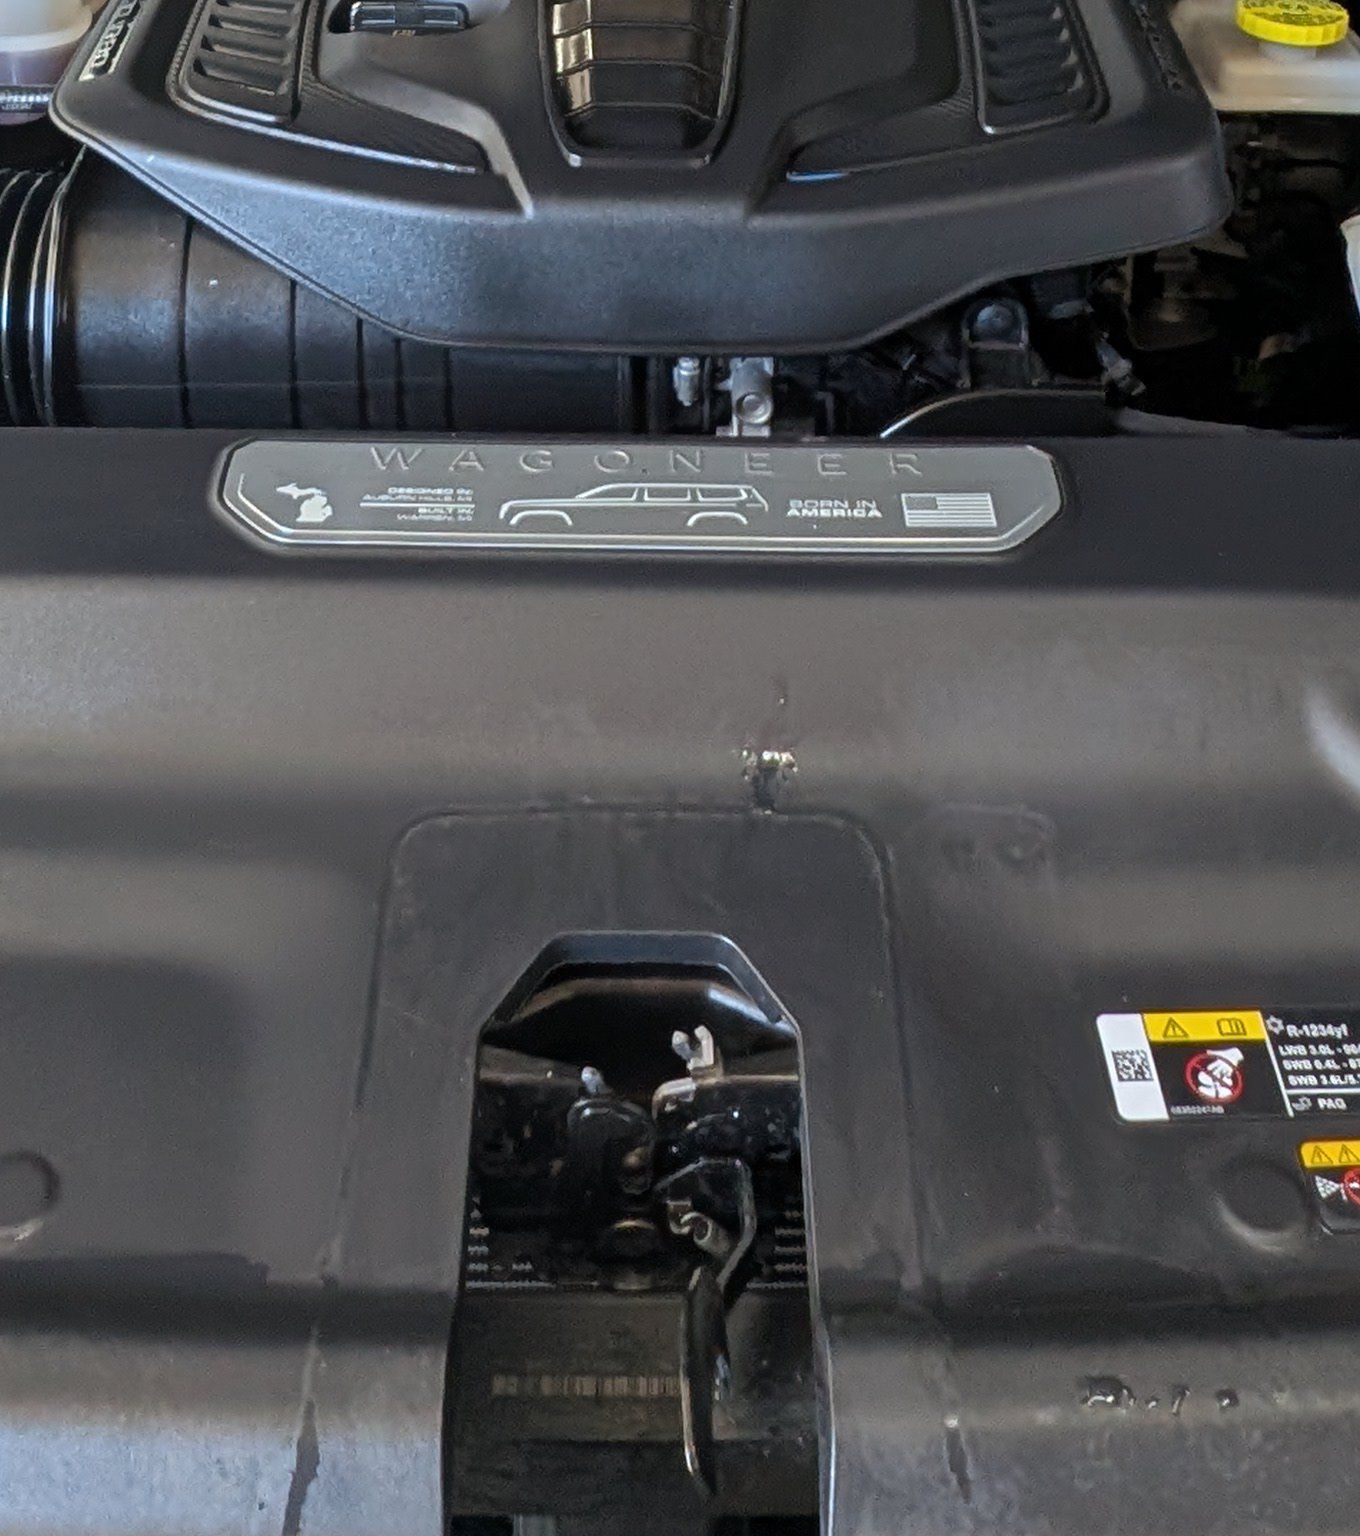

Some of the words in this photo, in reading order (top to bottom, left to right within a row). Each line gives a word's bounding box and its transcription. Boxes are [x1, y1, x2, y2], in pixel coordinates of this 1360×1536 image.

[370, 446, 923, 476] WAGONEER
[790, 499, 849, 509] BORN
[856, 500, 876, 509] IN
[786, 508, 883, 518] AMERICA
[1286, 1023, 1349, 1039] R-1234yf
[1278, 1044, 1308, 1056] LWB
[1282, 1059, 1313, 1070] SWB
[1287, 1074, 1318, 1086] SWB
